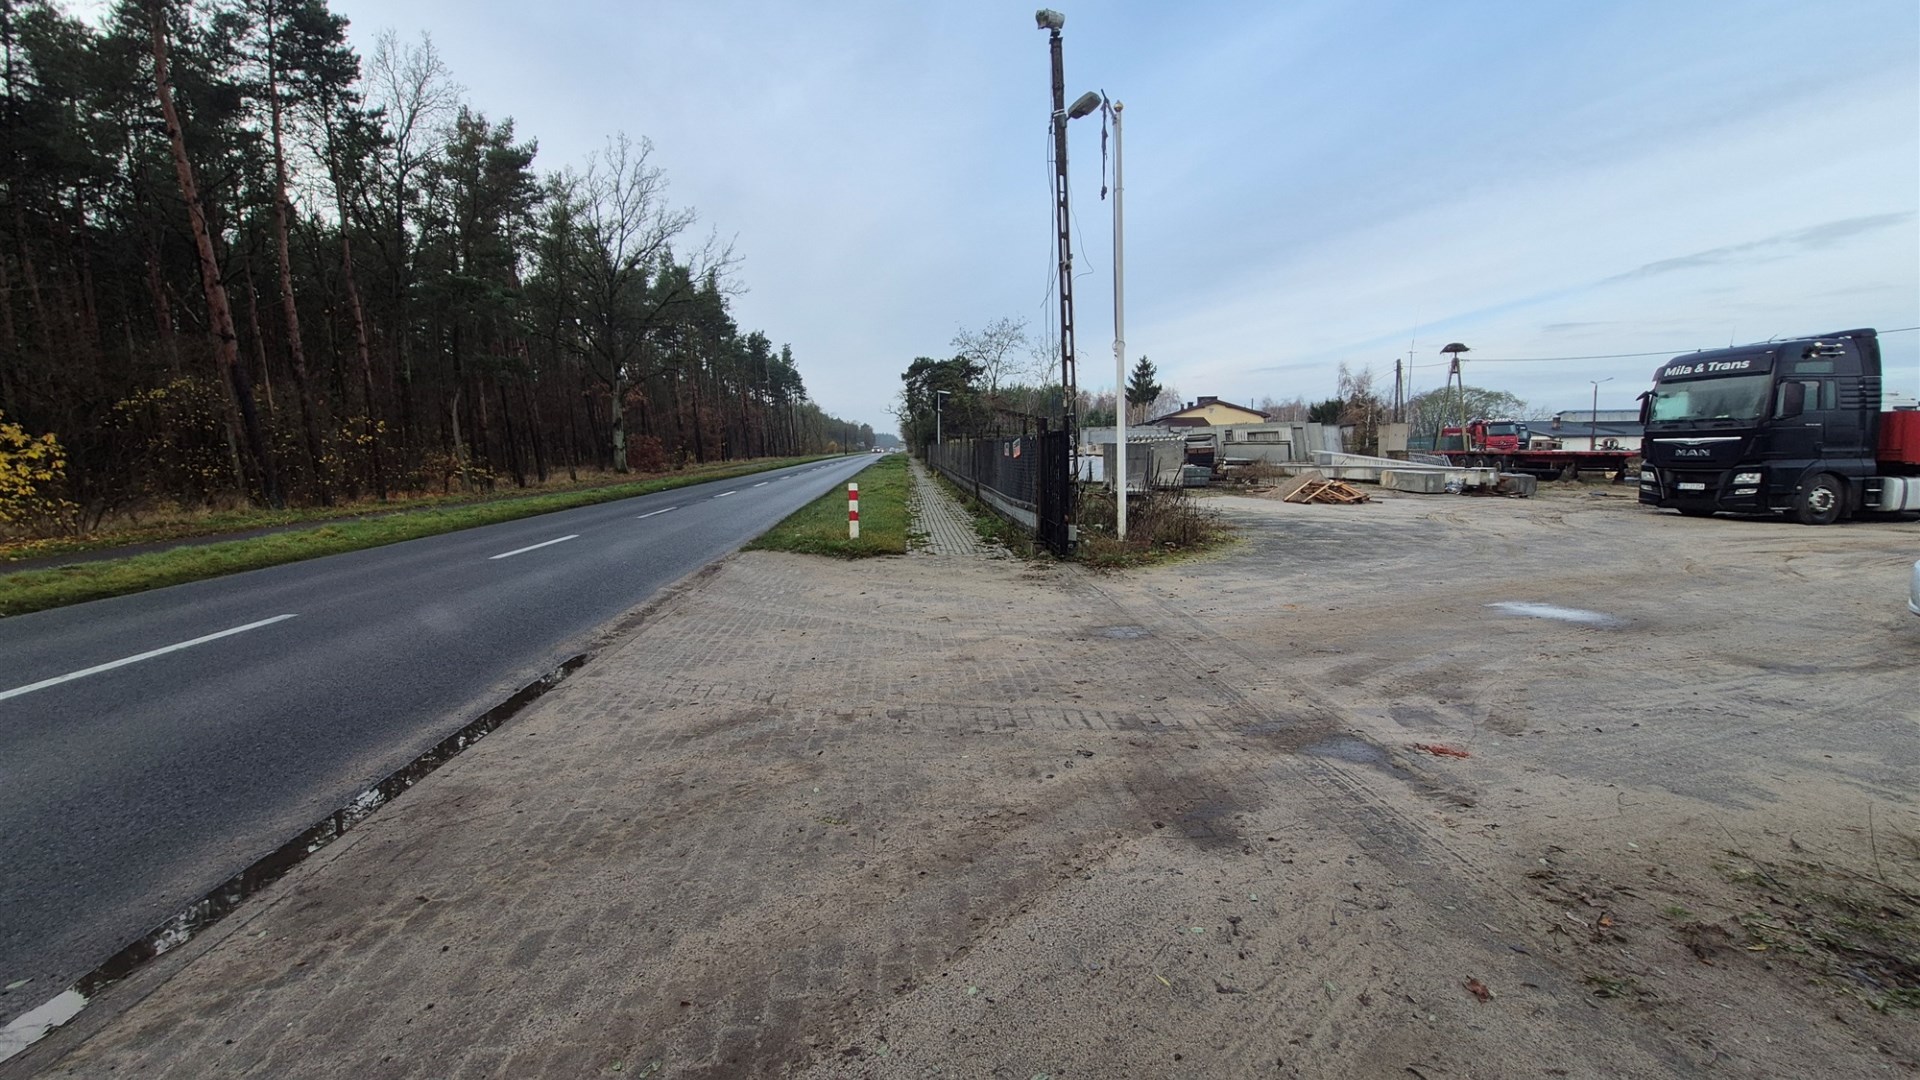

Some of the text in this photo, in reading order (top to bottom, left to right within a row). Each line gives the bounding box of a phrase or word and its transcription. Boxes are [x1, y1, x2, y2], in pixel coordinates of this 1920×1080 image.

[1664, 360, 1750, 377] Mila & Trans
